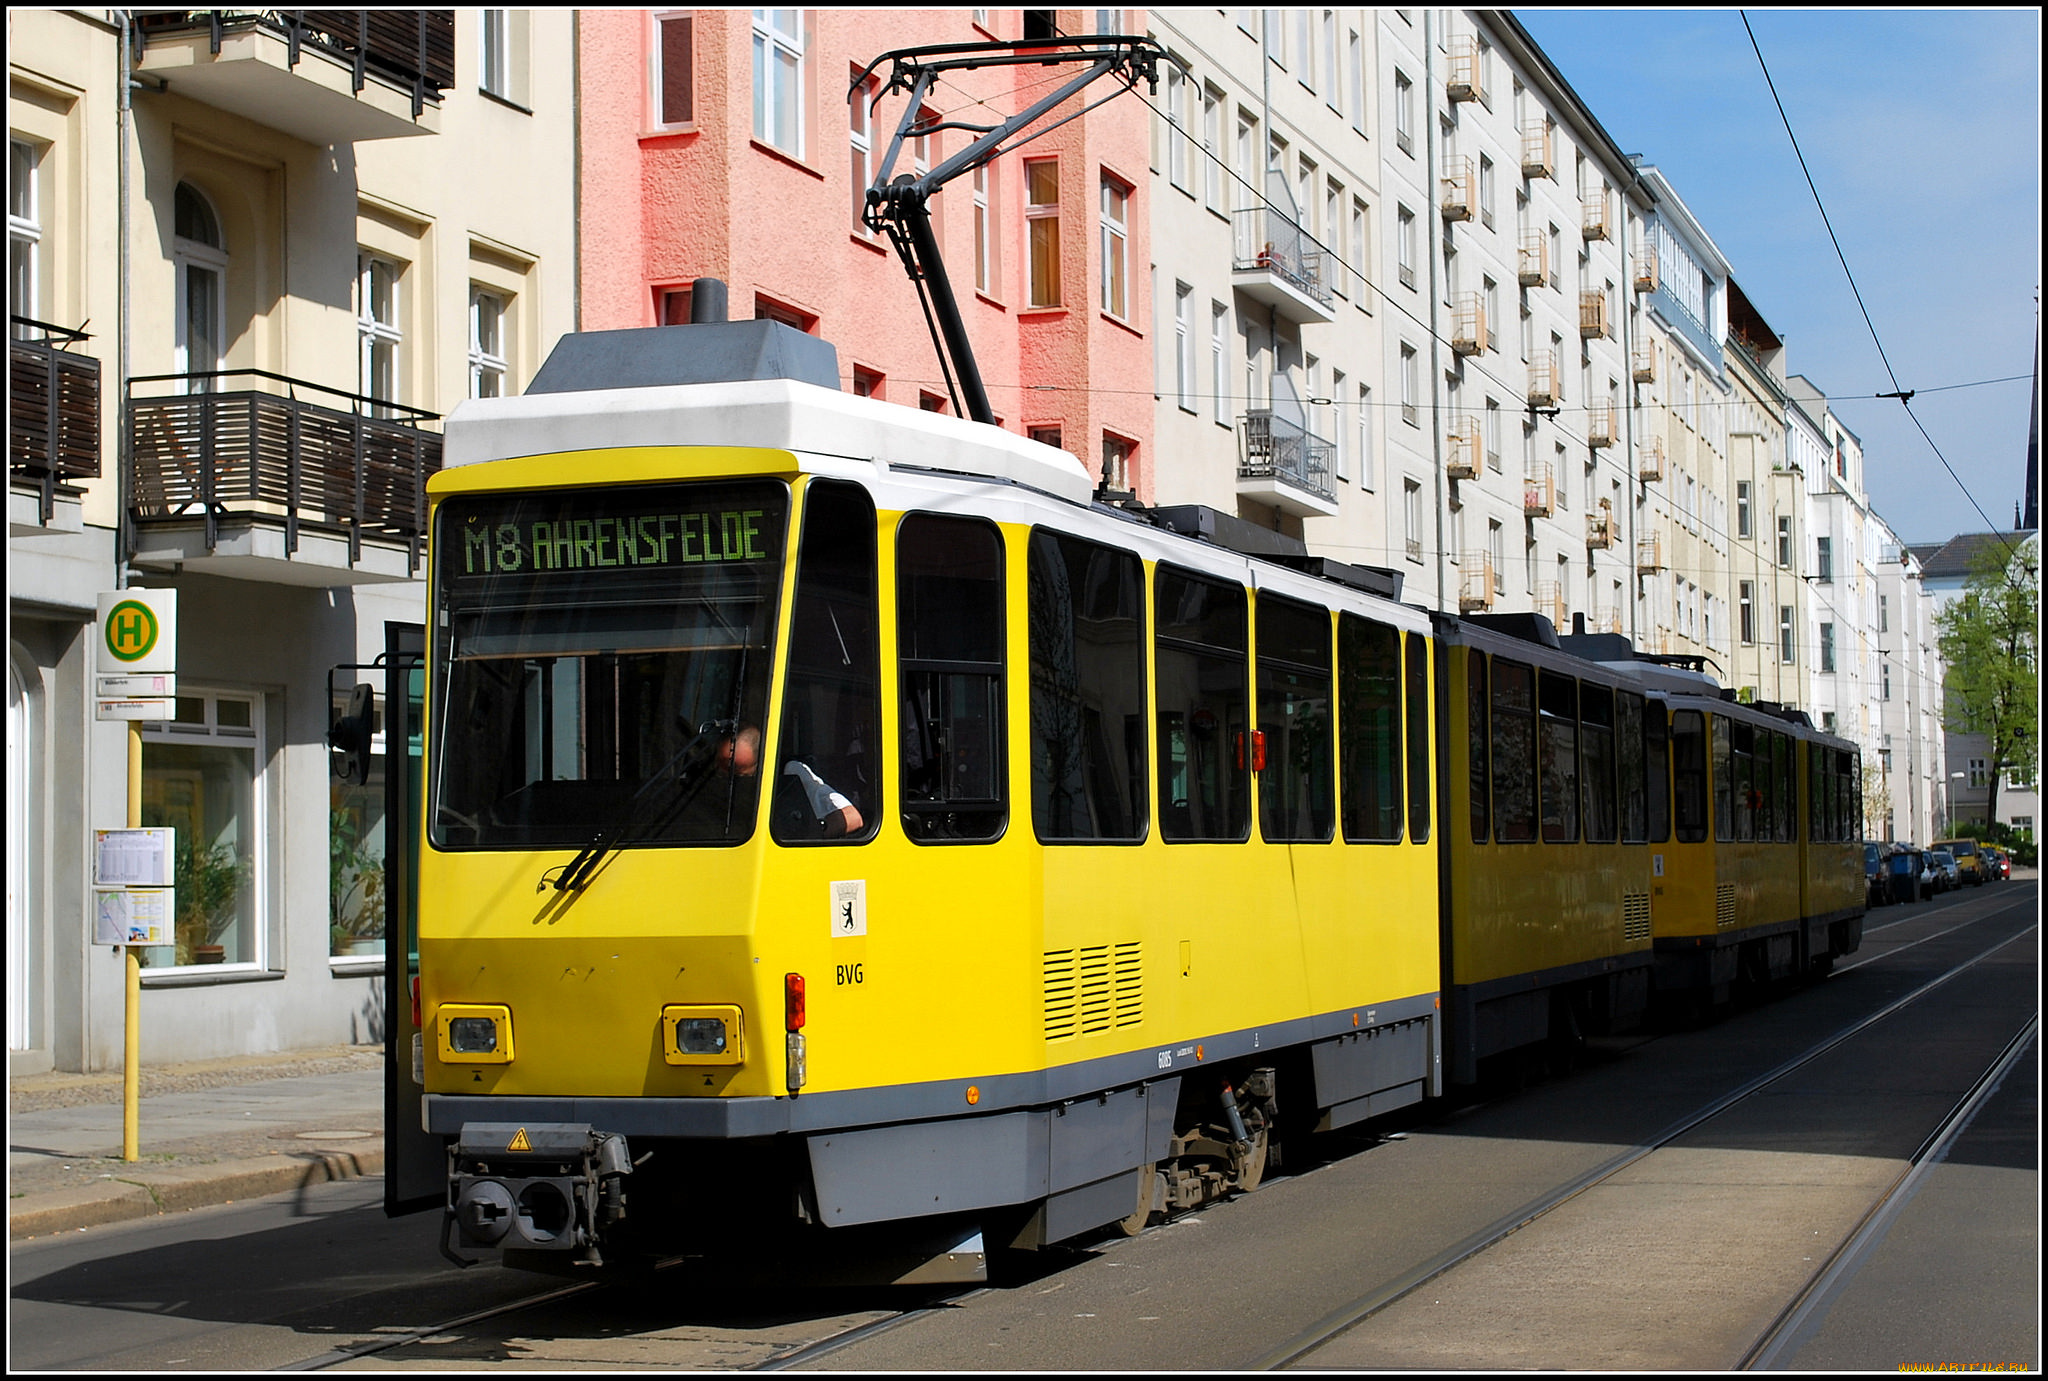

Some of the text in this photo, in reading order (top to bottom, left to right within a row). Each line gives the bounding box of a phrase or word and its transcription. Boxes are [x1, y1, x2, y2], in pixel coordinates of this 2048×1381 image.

[531, 510, 766, 570] AHRENSFELDE
[117, 614, 142, 647] H
[836, 963, 864, 986] BVG
